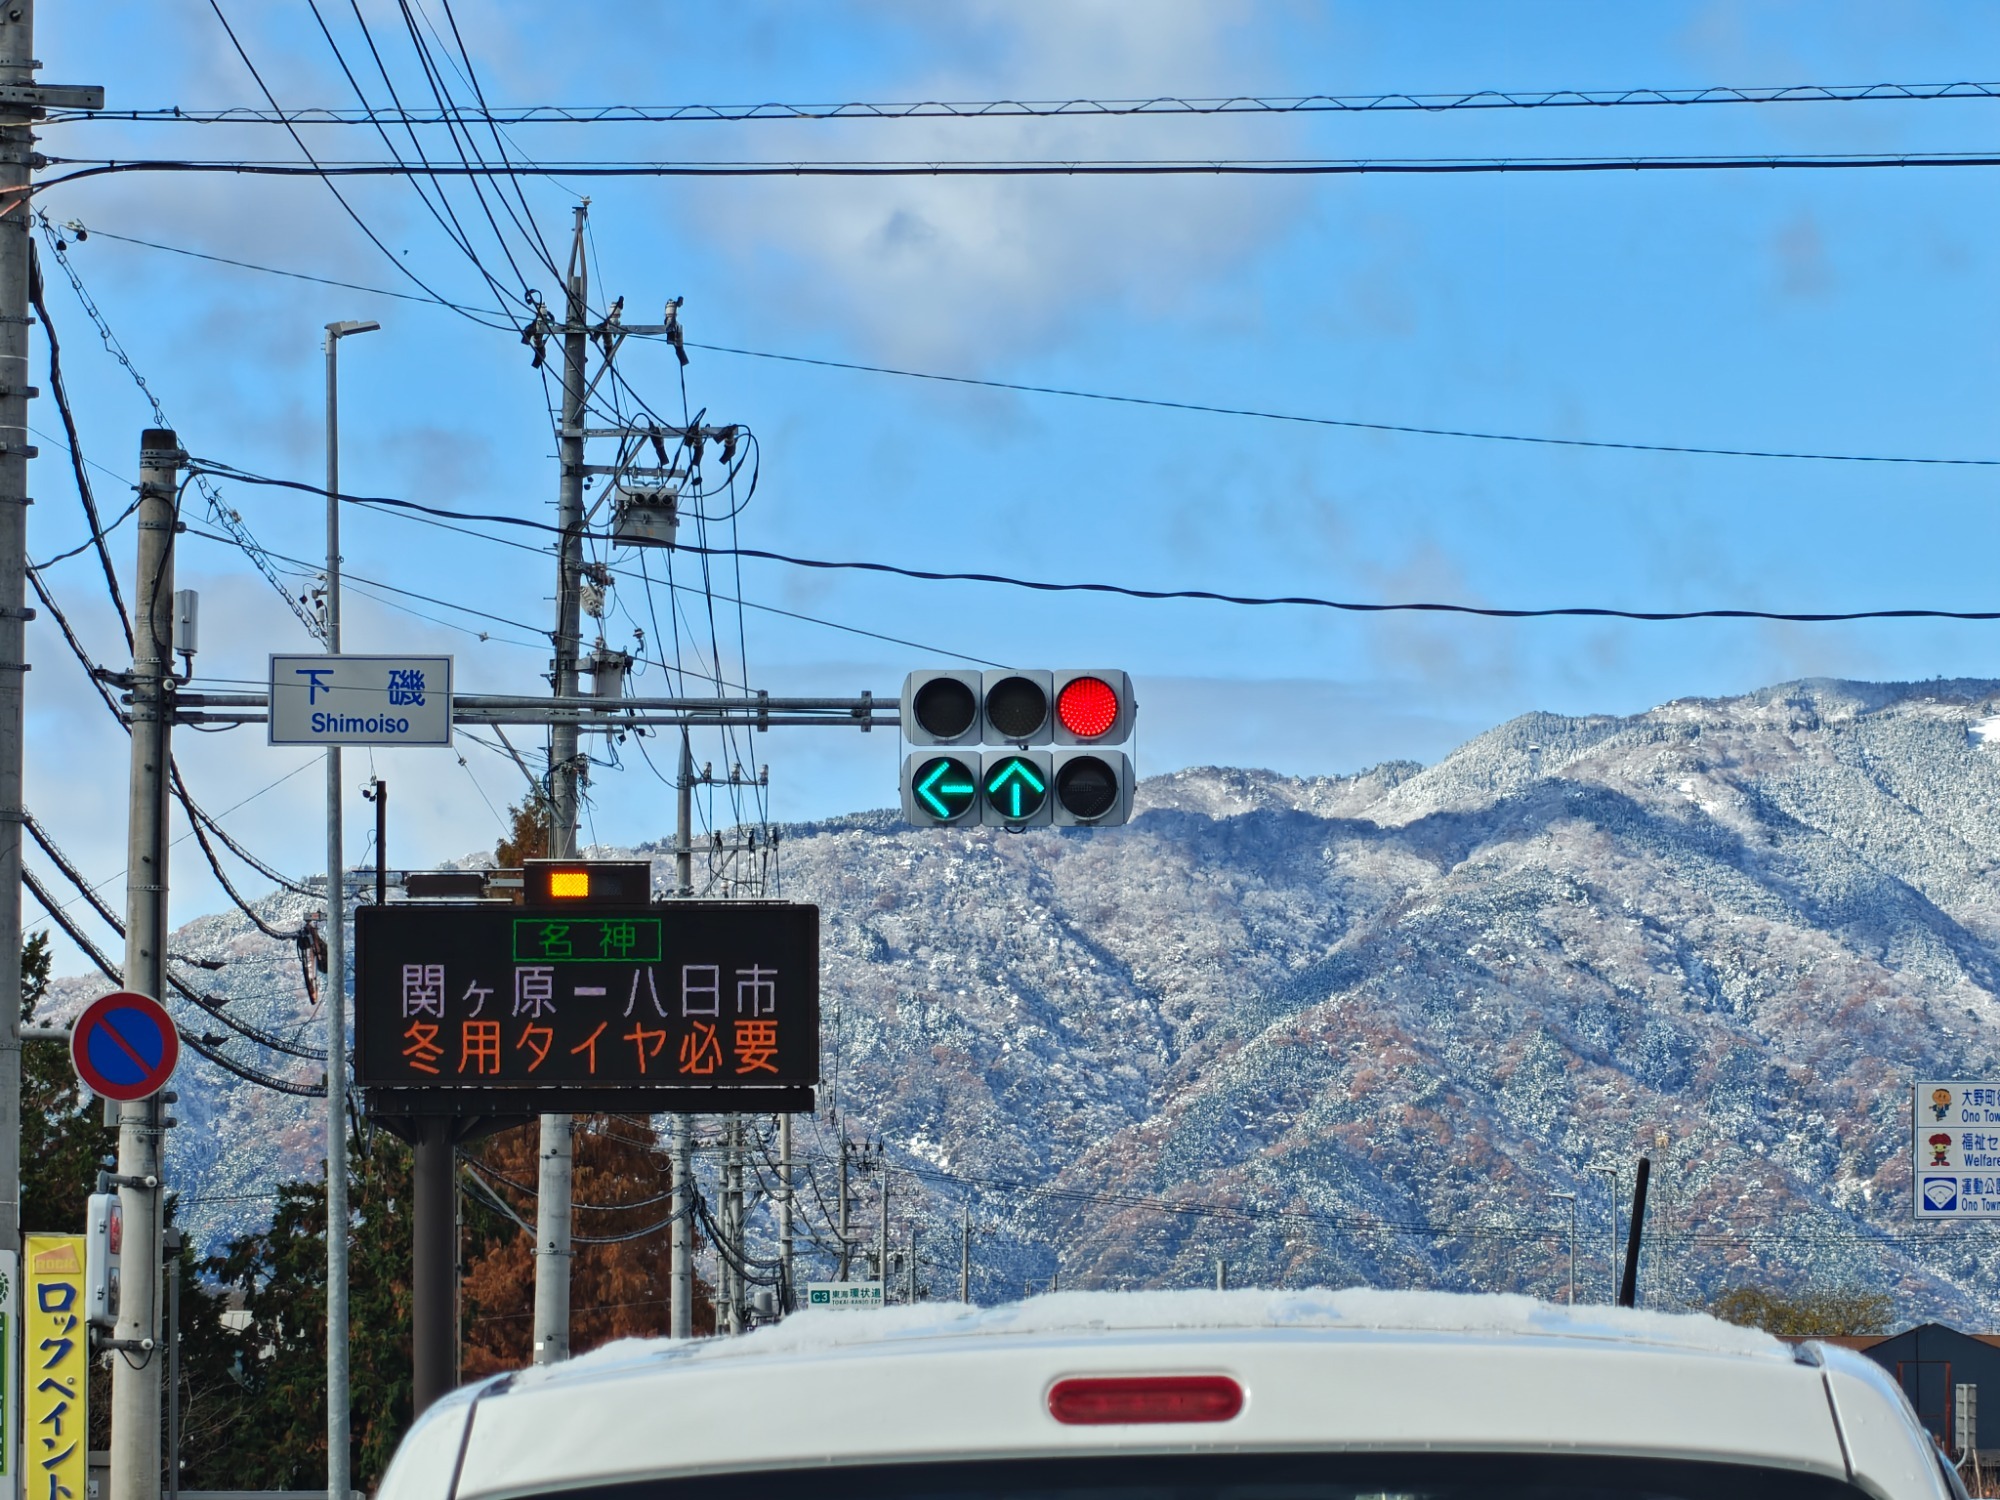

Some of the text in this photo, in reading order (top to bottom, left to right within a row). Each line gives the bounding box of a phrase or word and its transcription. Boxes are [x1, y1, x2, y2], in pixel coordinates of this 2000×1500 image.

[296, 669, 425, 706] 下磯
[311, 712, 410, 734] Shimoiso
[538, 923, 637, 957] 名神
[402, 1020, 779, 1075] 冬用タイヤ必要
[1962, 1109, 1980, 1122] Ono
[1962, 1133, 1998, 1150] 福祉セ
[1962, 1198, 1978, 1211] Ono
[36, 1259, 76, 1270] ROCK
[812, 1292, 828, 1302] C3
[36, 1282, 78, 1500] ロックペイント
